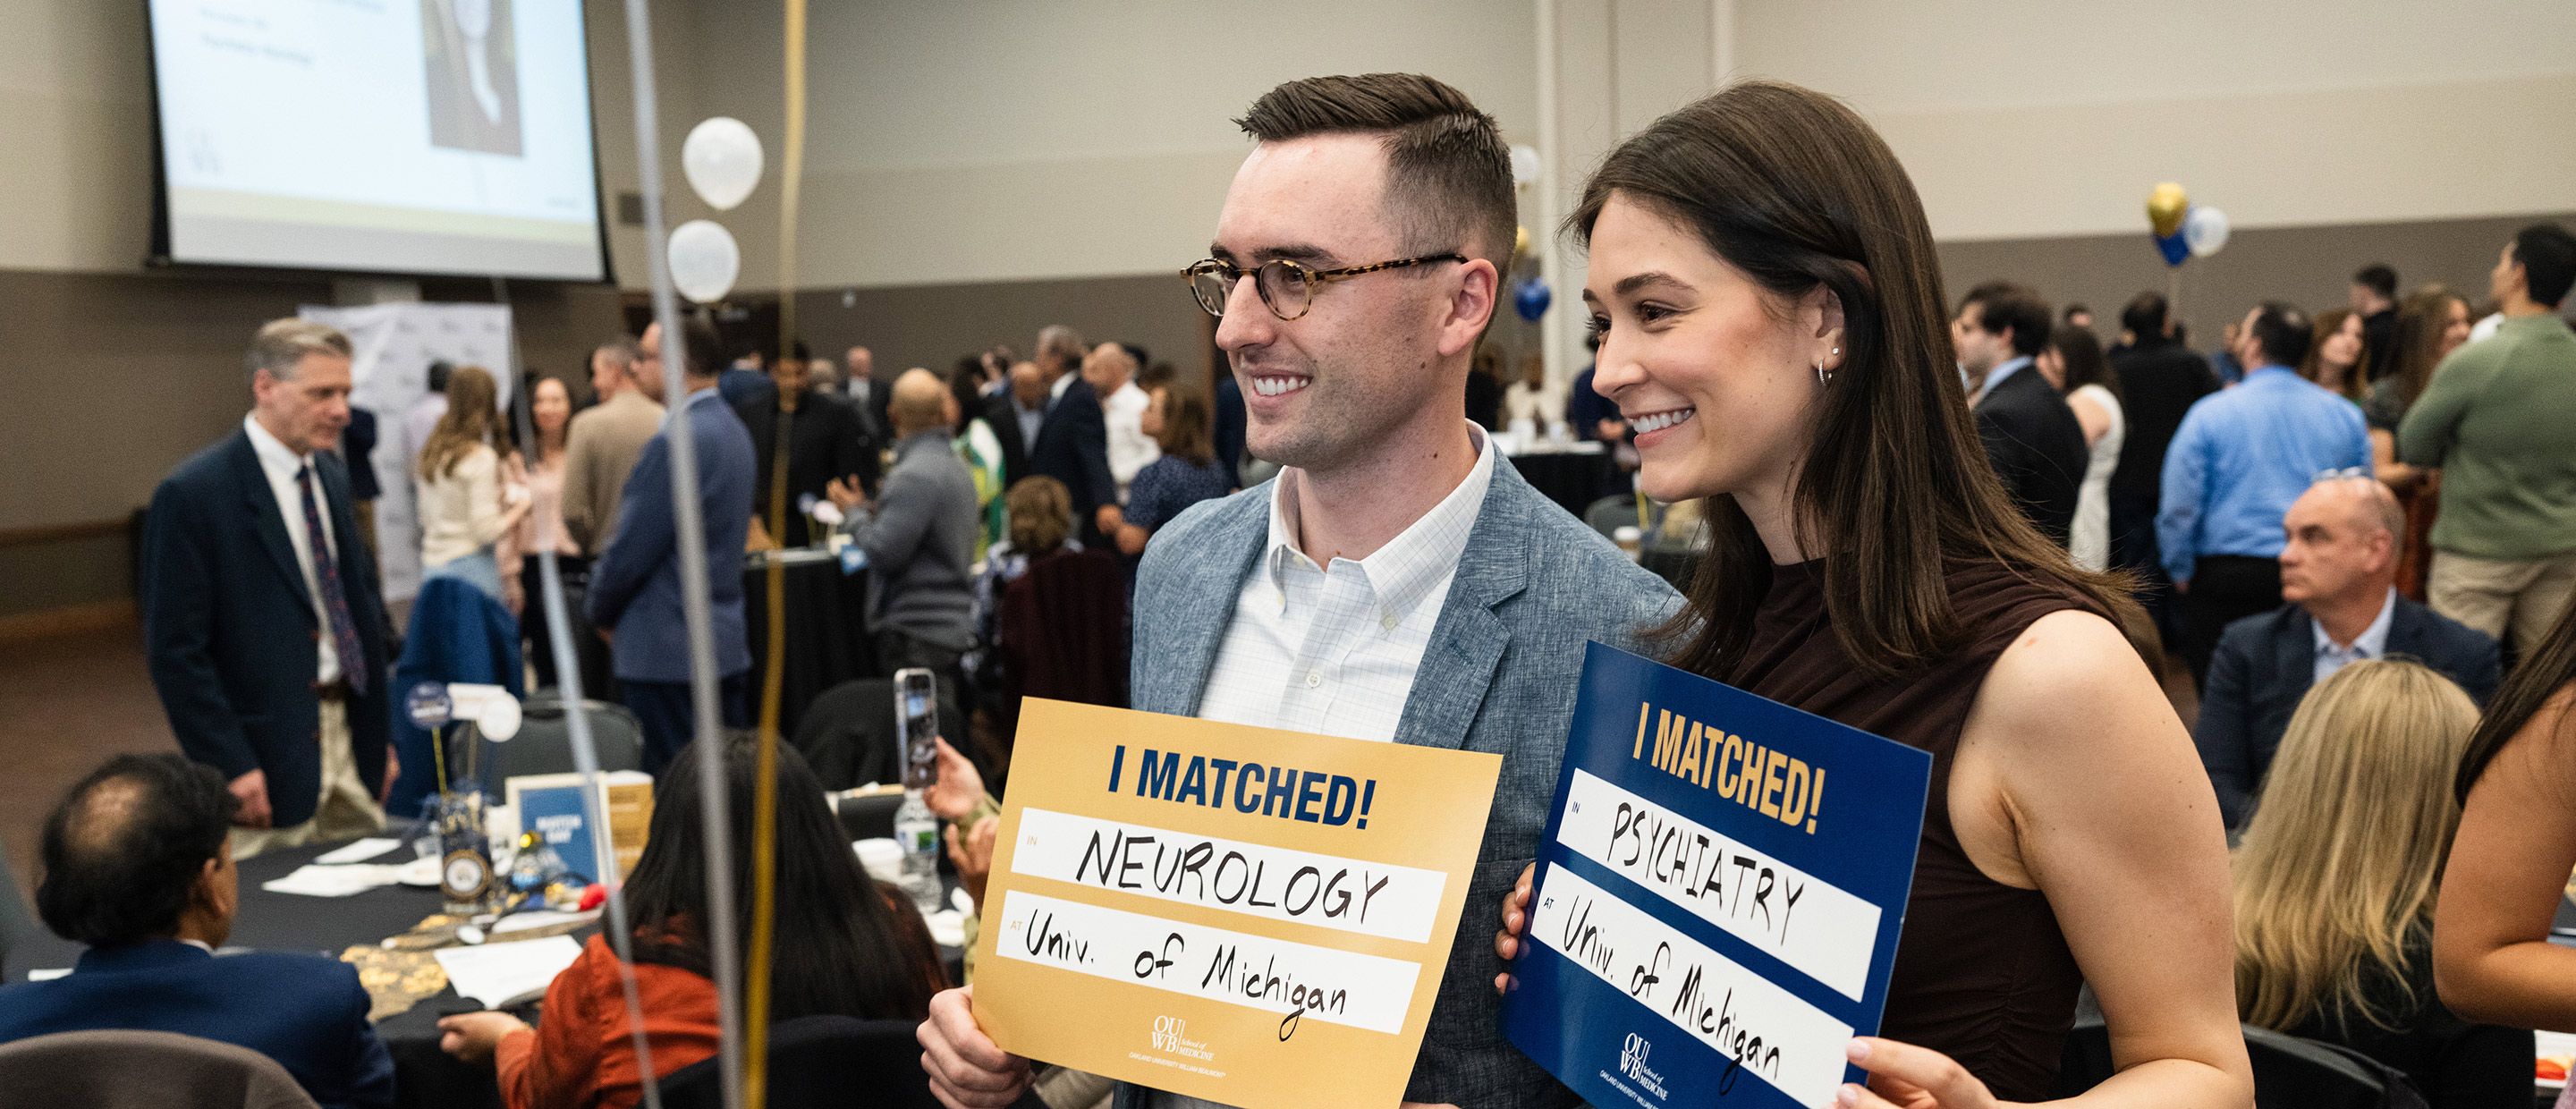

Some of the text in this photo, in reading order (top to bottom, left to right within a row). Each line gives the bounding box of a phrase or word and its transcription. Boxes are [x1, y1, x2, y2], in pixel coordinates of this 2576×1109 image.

[1632, 701, 1826, 835] I MATCHED!
[1108, 744, 1377, 830] I MATCHED!
[1572, 801, 1581, 814] IN
[1027, 836, 1038, 846] IN
[1075, 829, 1388, 925] NEUROLOGY
[1607, 802, 1804, 946] PSYCHIATRY
[1544, 897, 1555, 910] AT
[1010, 920, 1023, 931] AT
[1026, 909, 1347, 1043] Univ. of Michigan
[1564, 895, 1779, 1096] Univ. of Michigan
[1154, 1015, 1182, 1036] OU
[1152, 1031, 1178, 1053] WB
[1179, 1046, 1214, 1062] MEDICINE
[1625, 1032, 1648, 1060] OU
[1620, 1050, 1641, 1079] WB
[1639, 1075, 1668, 1101] MEDICINE
